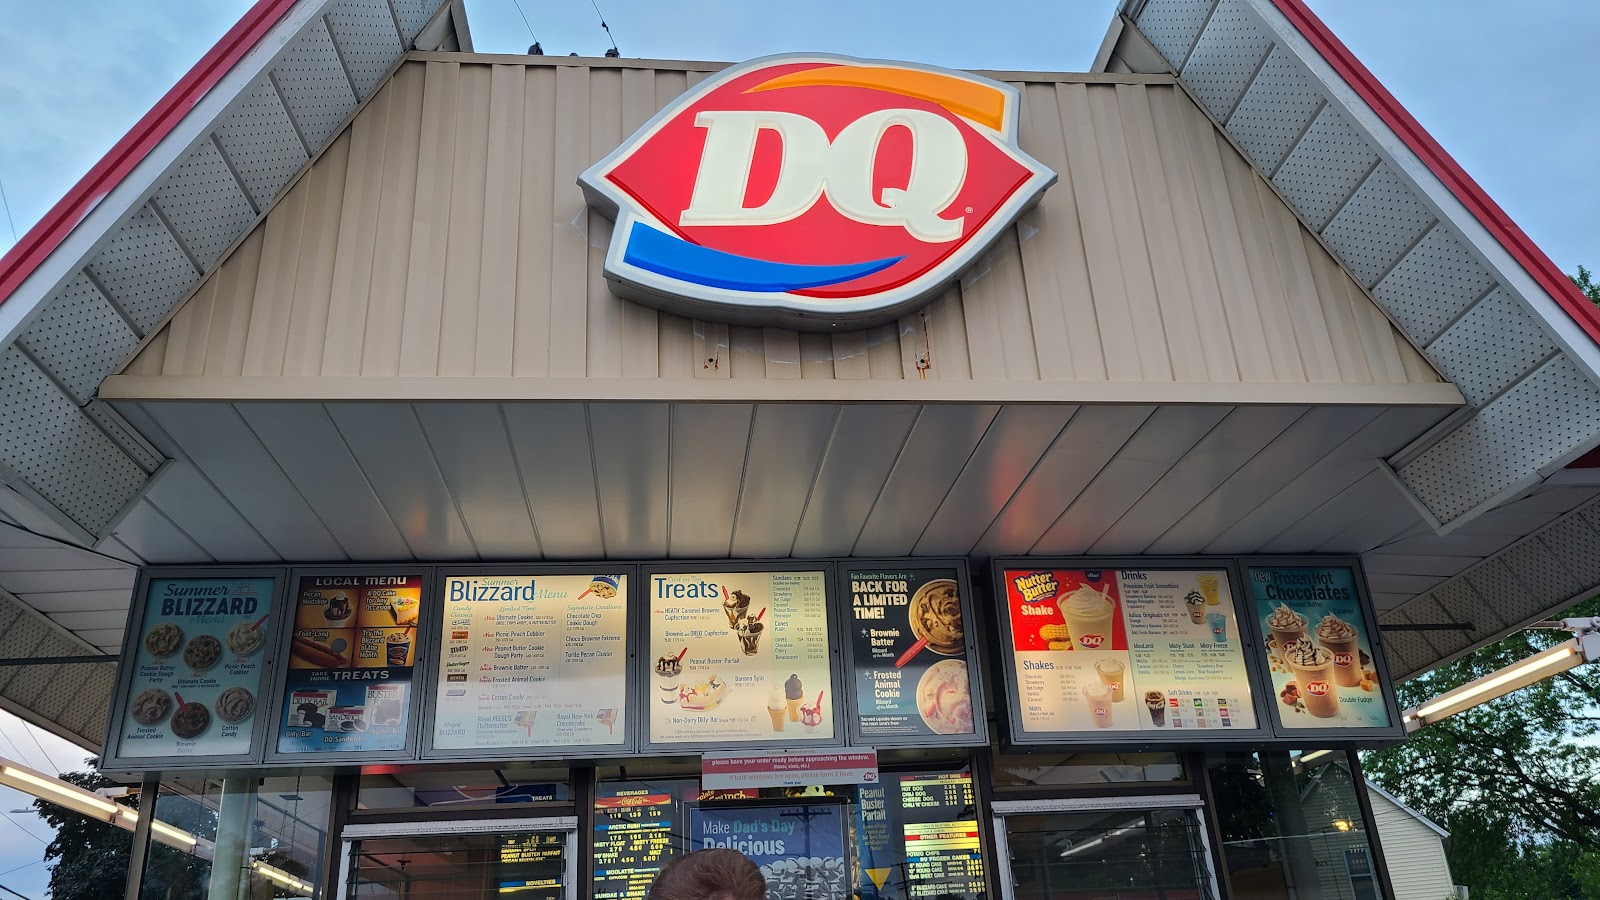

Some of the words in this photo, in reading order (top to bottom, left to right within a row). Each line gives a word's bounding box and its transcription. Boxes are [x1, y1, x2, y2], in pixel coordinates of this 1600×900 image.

[679, 108, 968, 243] DQ
[1122, 570, 1147, 580] Drinks
[1254, 571, 1271, 582] new
[1273, 572, 1312, 584] Frozen
[1313, 572, 1334, 584] Hot
[316, 578, 360, 586] LOCAL
[482, 578, 520, 586] Summer
[1014, 572, 1052, 590] Nutter
[164, 584, 231, 597] Summer
[450, 580, 536, 602] Blizzard
[654, 578, 718, 599] Treats
[852, 581, 884, 593] BACK
[886, 581, 908, 592] FOR
[1022, 580, 1058, 602] Butter
[1266, 584, 1350, 600] Chocolates
[534, 588, 568, 599] Menu
[852, 594, 862, 606] A
[863, 594, 908, 606] LIMITED
[161, 598, 258, 616] BLIZZARD
[1020, 604, 1054, 616] Shake
[853, 607, 885, 620] TIME!
[870, 628, 900, 638] Brownie
[871, 638, 894, 646] Batter
[1083, 636, 1102, 644] DQ
[1336, 655, 1351, 663] DQ
[1024, 660, 1054, 670] Shakes
[333, 671, 390, 680] TREATS
[874, 671, 902, 680] Frosted
[874, 680, 900, 688] Animal
[1310, 684, 1328, 692] DQ
[875, 690, 900, 698] Cookie
[860, 787, 885, 798] Peanut
[861, 800, 884, 810] Buster
[862, 810, 886, 821] Parfait
[704, 820, 730, 834] Make
[734, 820, 768, 832] Dad's
[772, 819, 796, 835] Day
